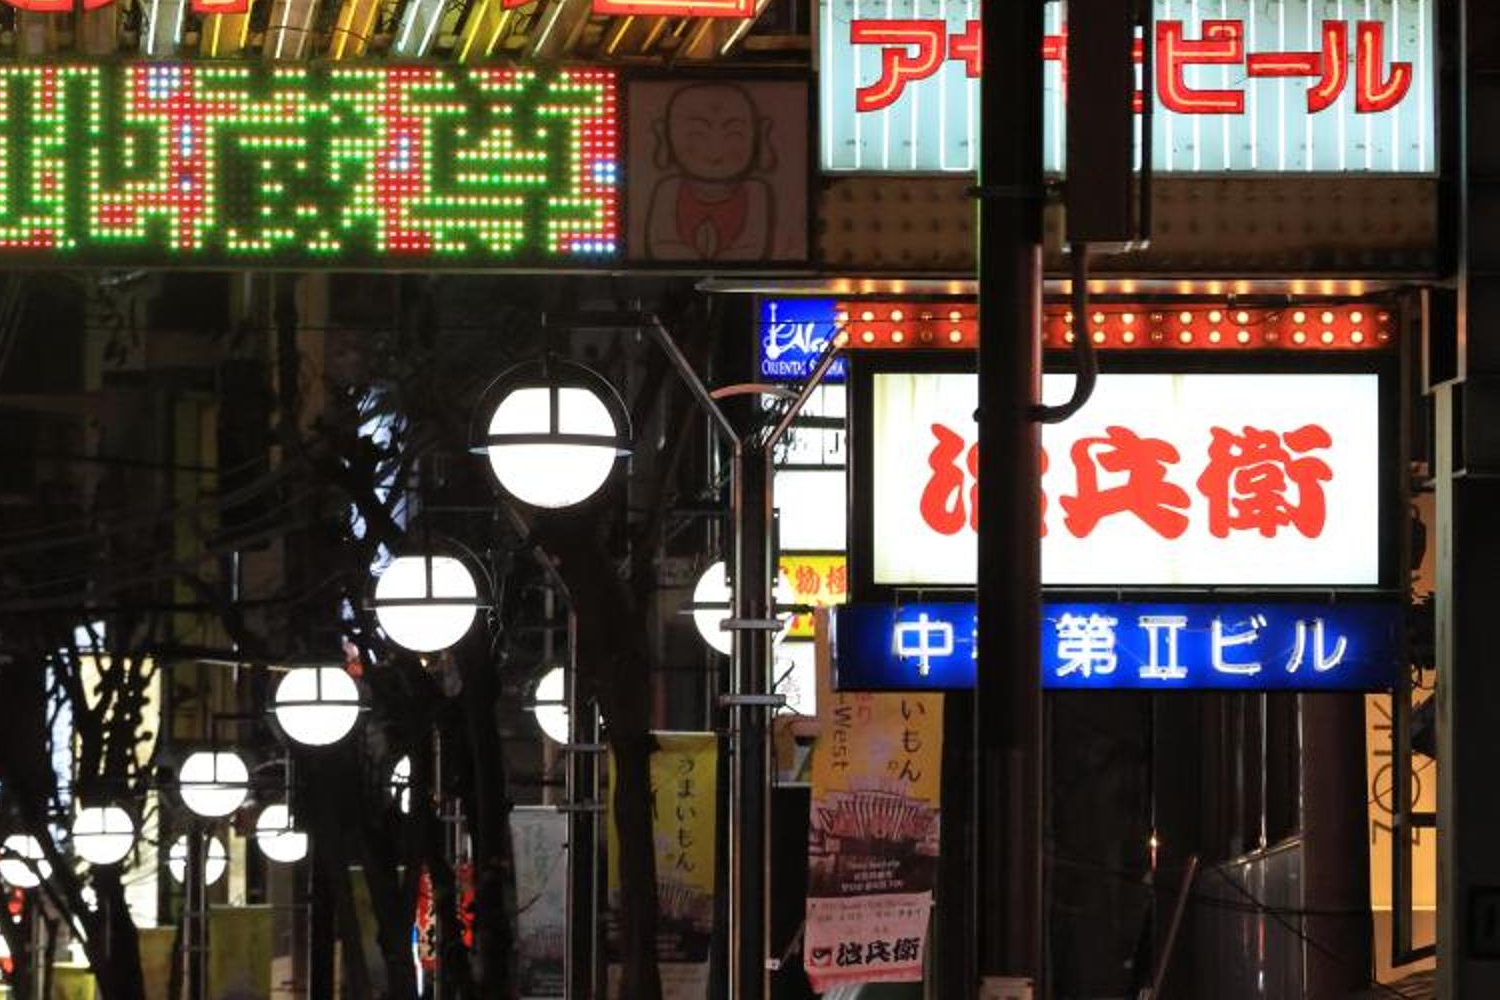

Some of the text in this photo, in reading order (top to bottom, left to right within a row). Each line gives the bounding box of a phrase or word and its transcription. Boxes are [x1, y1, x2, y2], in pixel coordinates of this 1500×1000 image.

[850, 18, 1413, 115] アビール
[892, 612, 1349, 680] 中第Ⅱビル
